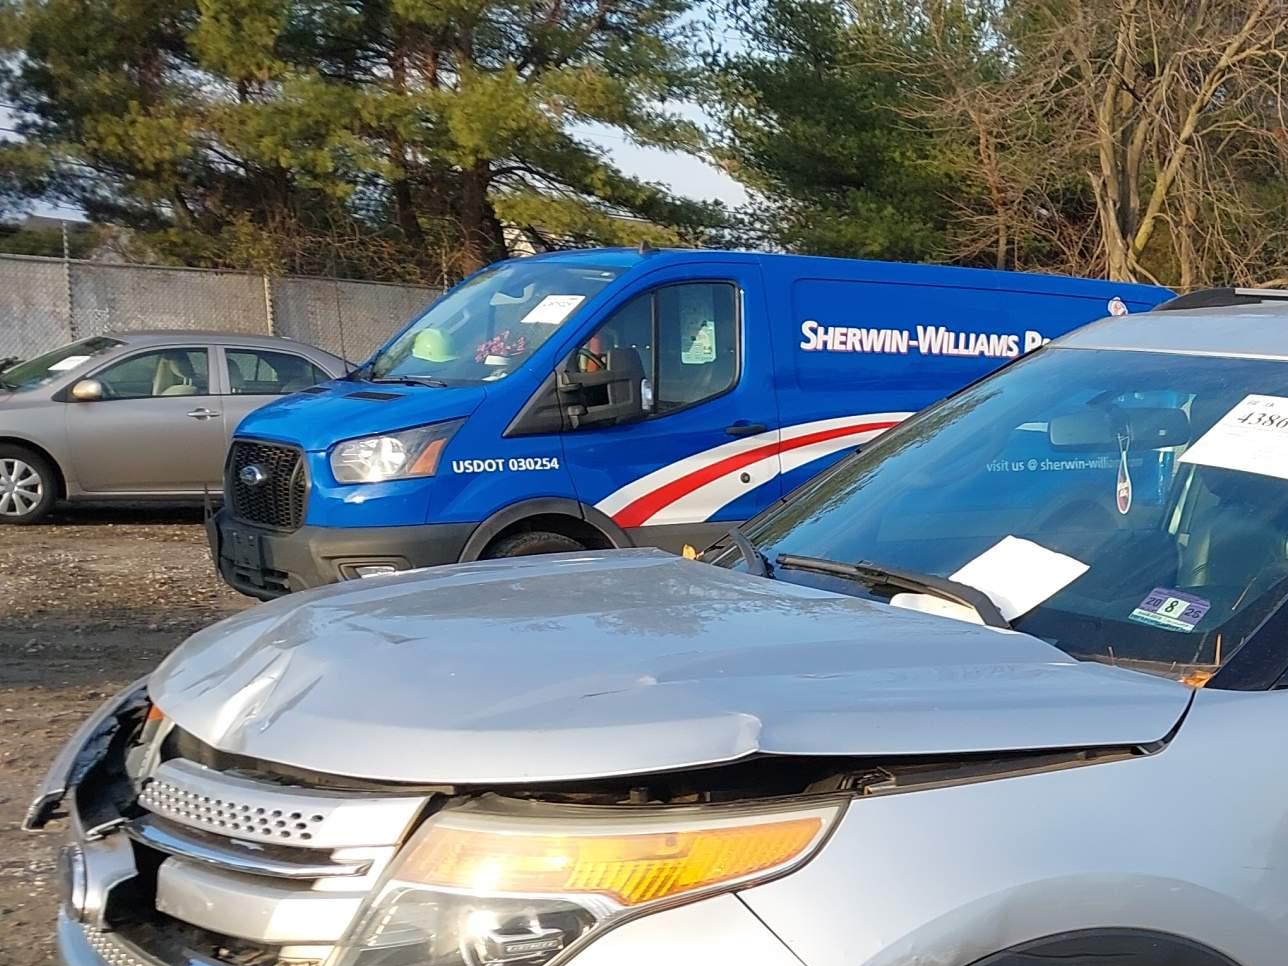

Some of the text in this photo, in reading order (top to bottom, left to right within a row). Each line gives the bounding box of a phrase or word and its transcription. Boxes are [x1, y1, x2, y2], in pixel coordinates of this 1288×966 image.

[452, 457, 560, 473] USDOT 030254
[986, 459, 1009, 472] visit
[1012, 461, 1025, 472] us
[1027, 458, 1039, 471] @
[1165, 600, 1179, 613] 8
